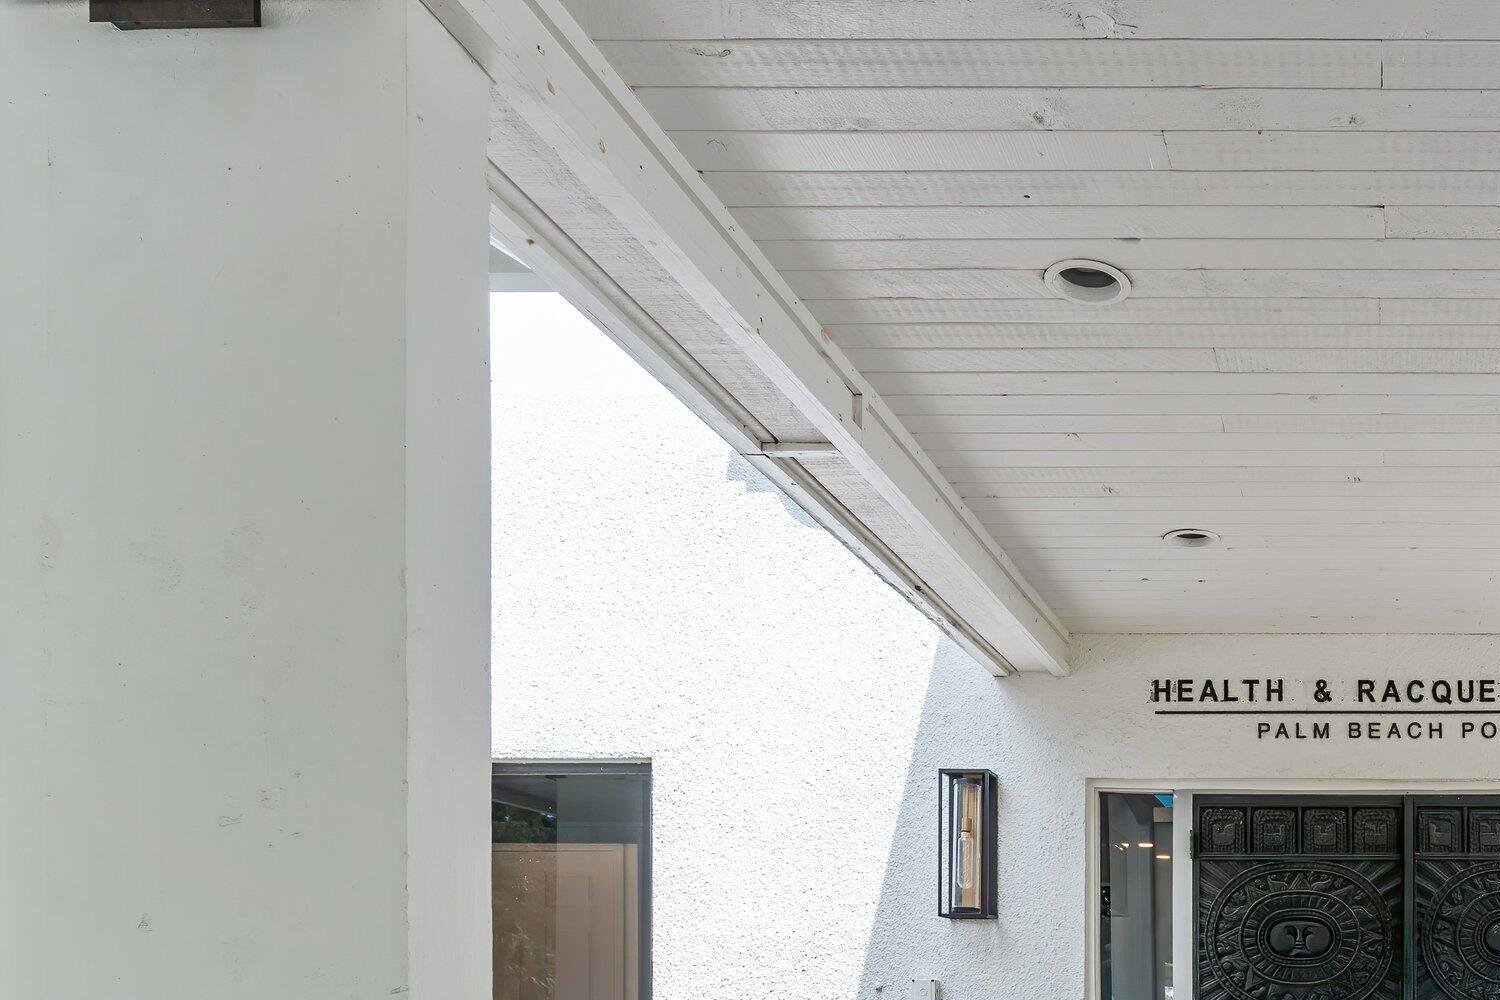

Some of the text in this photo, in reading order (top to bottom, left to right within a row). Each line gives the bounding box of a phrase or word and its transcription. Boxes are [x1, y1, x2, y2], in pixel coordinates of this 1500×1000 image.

[1151, 679, 1283, 702] HEALTH
[1313, 679, 1331, 702] &
[1257, 722, 1330, 739] PALM
[1349, 722, 1443, 739] BEACH
